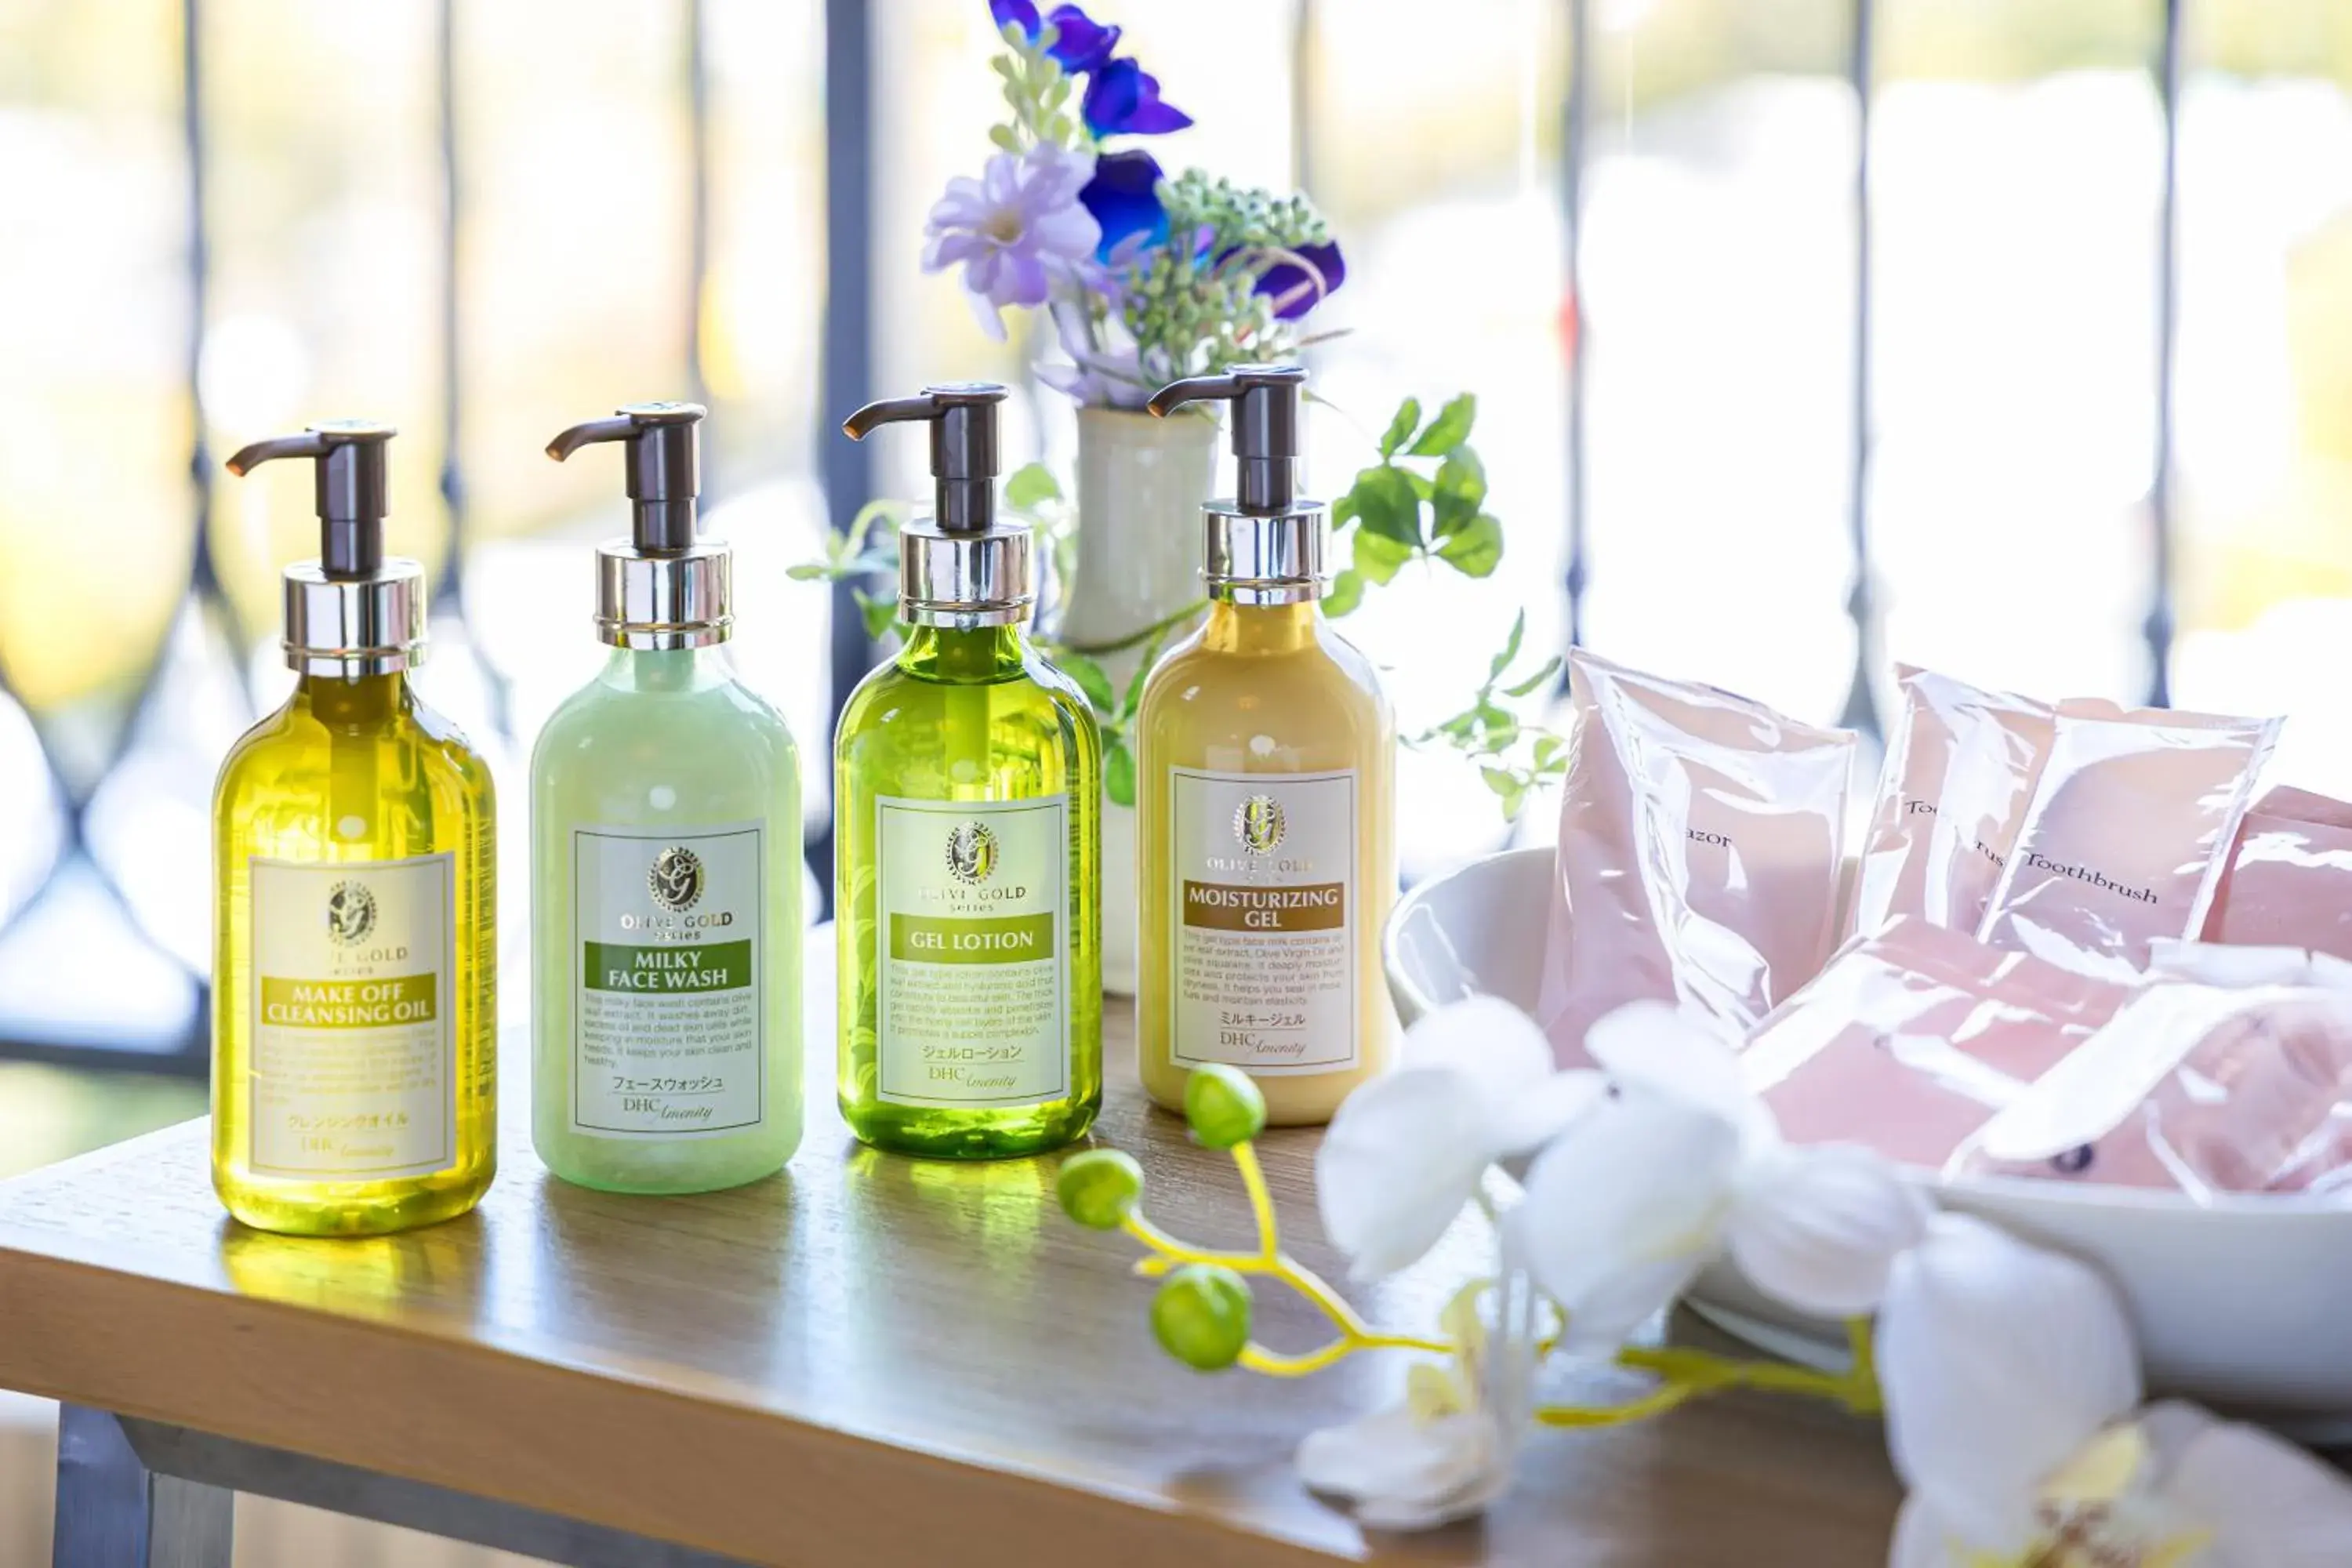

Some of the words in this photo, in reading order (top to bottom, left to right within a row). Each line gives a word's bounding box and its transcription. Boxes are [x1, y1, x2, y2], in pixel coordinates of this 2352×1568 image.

[1905, 800, 1938, 815] To
[1686, 828, 1730, 848] azor
[2027, 853, 2159, 904] Toothbrush
[978, 887, 1026, 900] GOLD
[1189, 887, 1338, 908] MOISTURIZING
[684, 912, 732, 928] GOLD
[1244, 911, 1282, 927] GEL
[911, 932, 946, 949] GEL
[953, 931, 1033, 949] LOTION
[636, 951, 702, 968] MILKY
[609, 970, 659, 989] FACE
[665, 969, 727, 989] WASH
[293, 985, 355, 1004] MAKE
[361, 983, 405, 1002] OFF
[267, 1003, 389, 1024] CLEANSING
[394, 1000, 430, 1019] OIL
[1220, 1032, 1255, 1047] DHC
[923, 1045, 1022, 1060] ジェルローション
[929, 1066, 965, 1080] DHC
[612, 1076, 723, 1091] フェースウォッシュ
[623, 1098, 661, 1112] DHC
